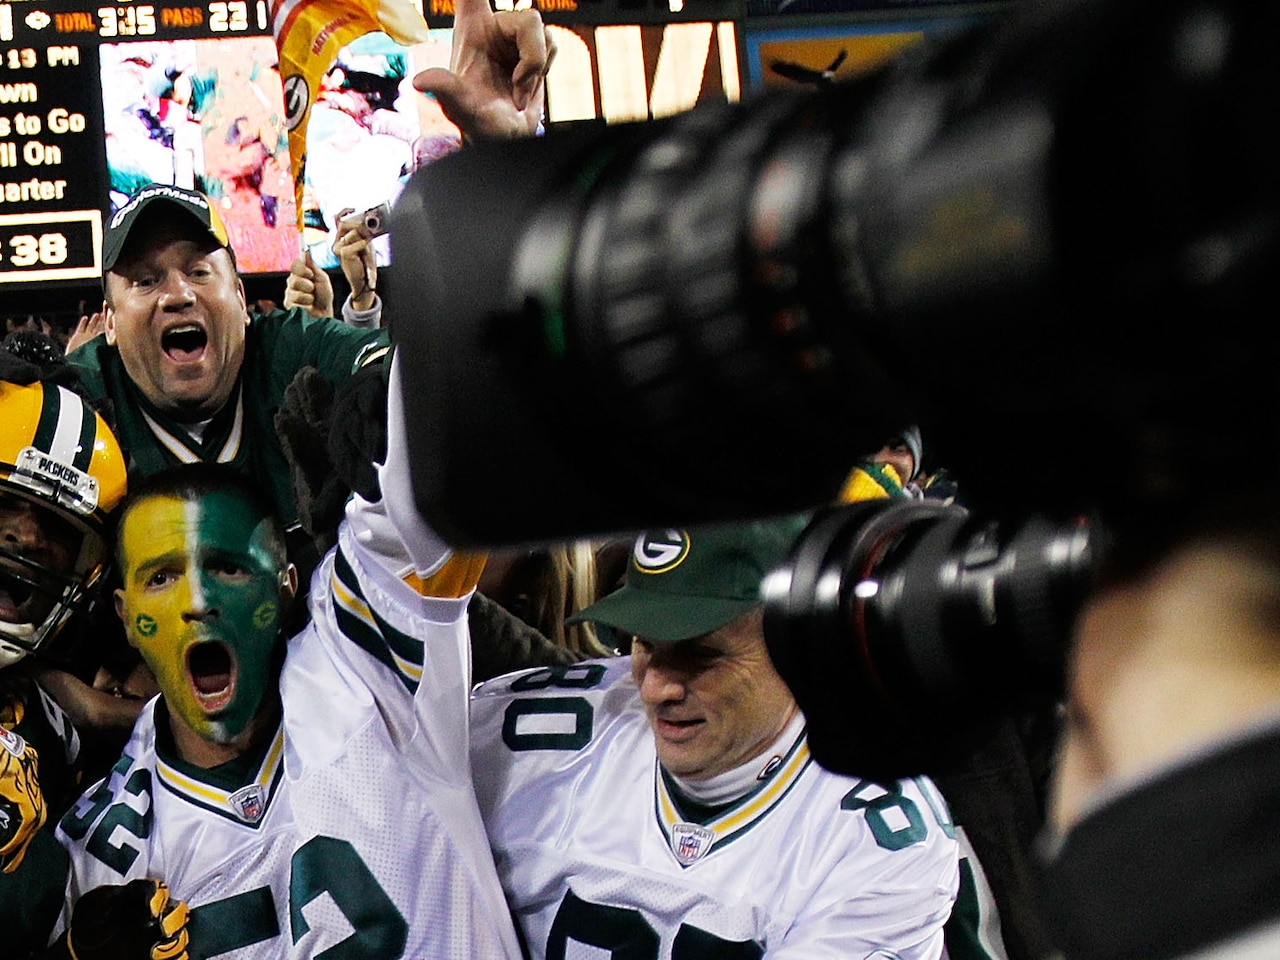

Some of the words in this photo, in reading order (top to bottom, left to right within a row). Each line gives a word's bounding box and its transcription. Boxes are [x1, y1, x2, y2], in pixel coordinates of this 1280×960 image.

[55, 12, 96, 32] TOTAL
[161, 8, 203, 27] PASS
[46, 45, 80, 67] PM
[13, 111, 41, 135] to
[47, 108, 86, 134] Go
[23, 140, 62, 166] On
[38, 457, 80, 486] PACKERS
